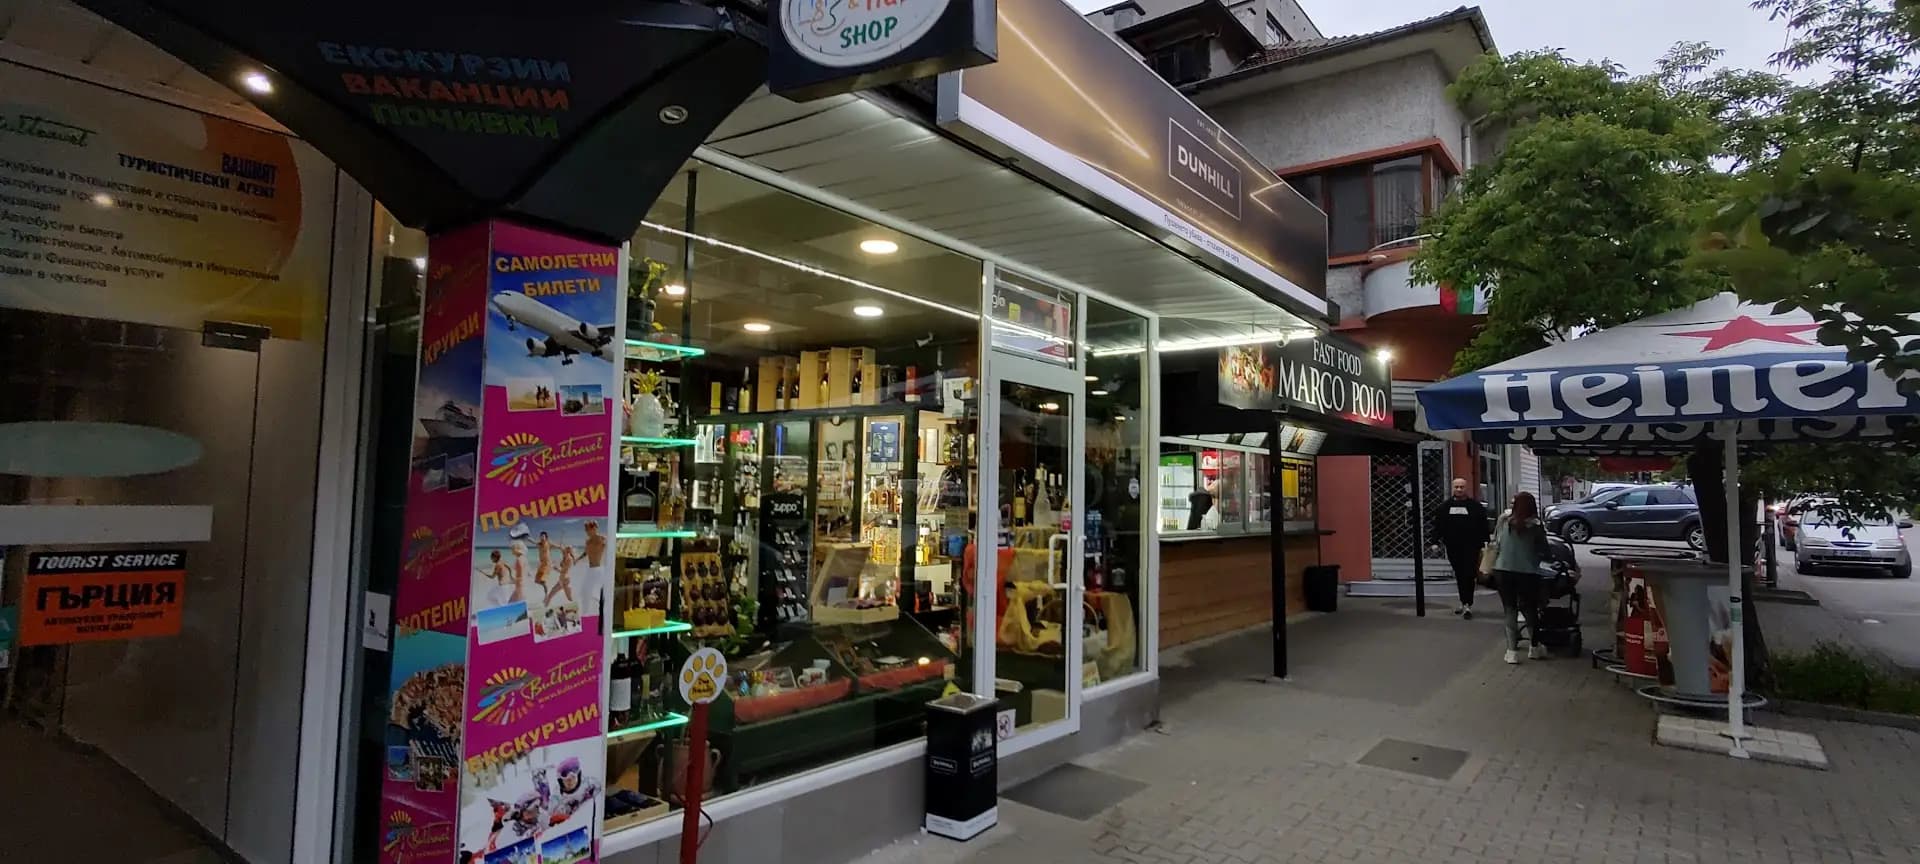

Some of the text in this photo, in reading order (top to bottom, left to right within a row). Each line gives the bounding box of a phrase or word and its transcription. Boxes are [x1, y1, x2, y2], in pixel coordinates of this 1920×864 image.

[840, 16, 898, 49] SHOP
[317, 40, 571, 82] ЕКСКУРЗИИ
[341, 71, 569, 111] ВАКАНЦИИ
[370, 102, 559, 140] ПОЧИВКИ
[118, 152, 274, 199] ТУРИСТИЧЕСКИ АГЕНТ
[1178, 144, 1234, 199] DUNHILL
[147, 203, 199, 222] чужбина
[50, 272, 107, 288] чужбина
[124, 264, 164, 279] услуги
[495, 252, 616, 273] САМОЛЕТНИ
[523, 278, 601, 297] БИЛЕТИ
[424, 311, 480, 366] КРУИЗИ
[1313, 339, 1362, 377] FAST FOOD
[1278, 356, 1387, 421] MARCO POLO
[532, 432, 605, 468] Bultravel
[480, 483, 607, 534] ПОЧИВКИ
[36, 582, 177, 611] ГЪРЦИЯ
[398, 596, 466, 635] ХОТЕЛИ
[521, 650, 598, 700] Bultravel
[467, 703, 599, 775] ЕКСКУРЗИИ
